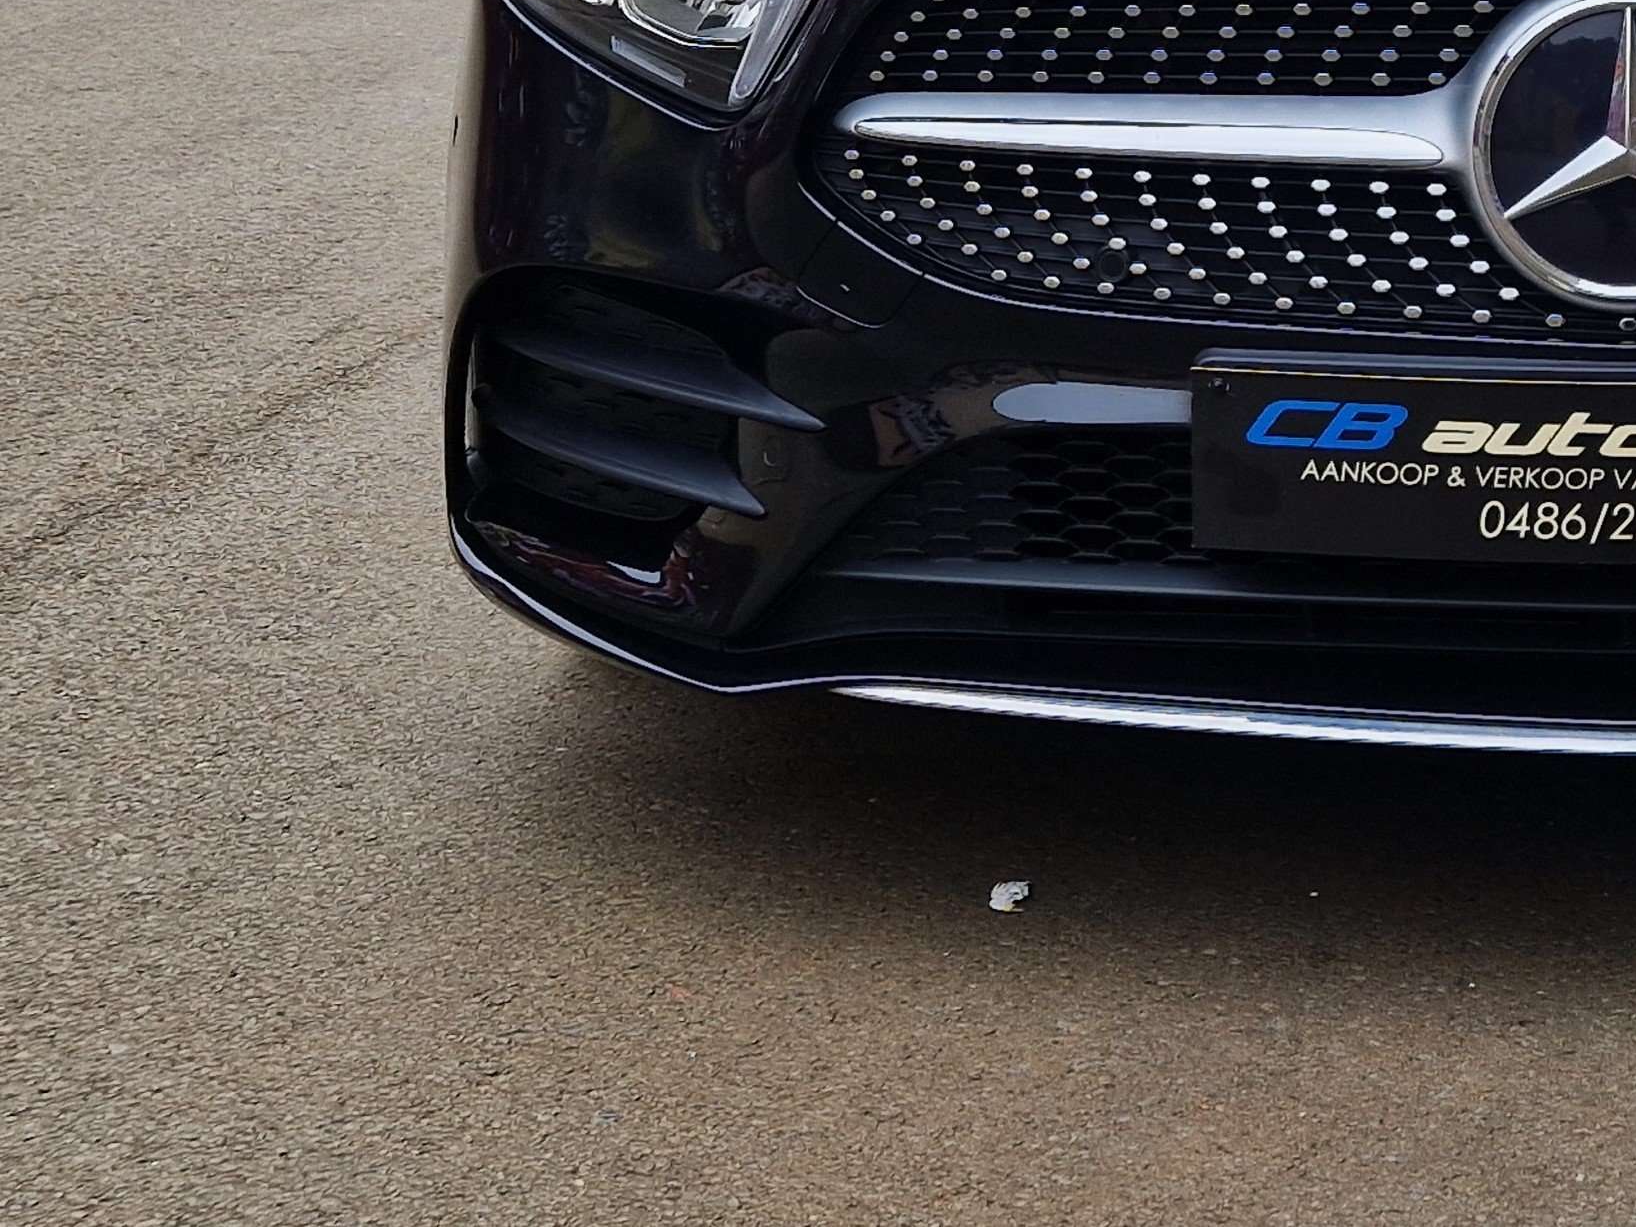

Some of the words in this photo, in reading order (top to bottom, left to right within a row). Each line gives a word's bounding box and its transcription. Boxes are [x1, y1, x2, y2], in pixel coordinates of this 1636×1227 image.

[1246, 400, 1408, 450] CB
[1301, 459, 1439, 485] AANKOOP
[1447, 466, 1465, 486] &
[1476, 466, 1605, 489] VERKOOP
